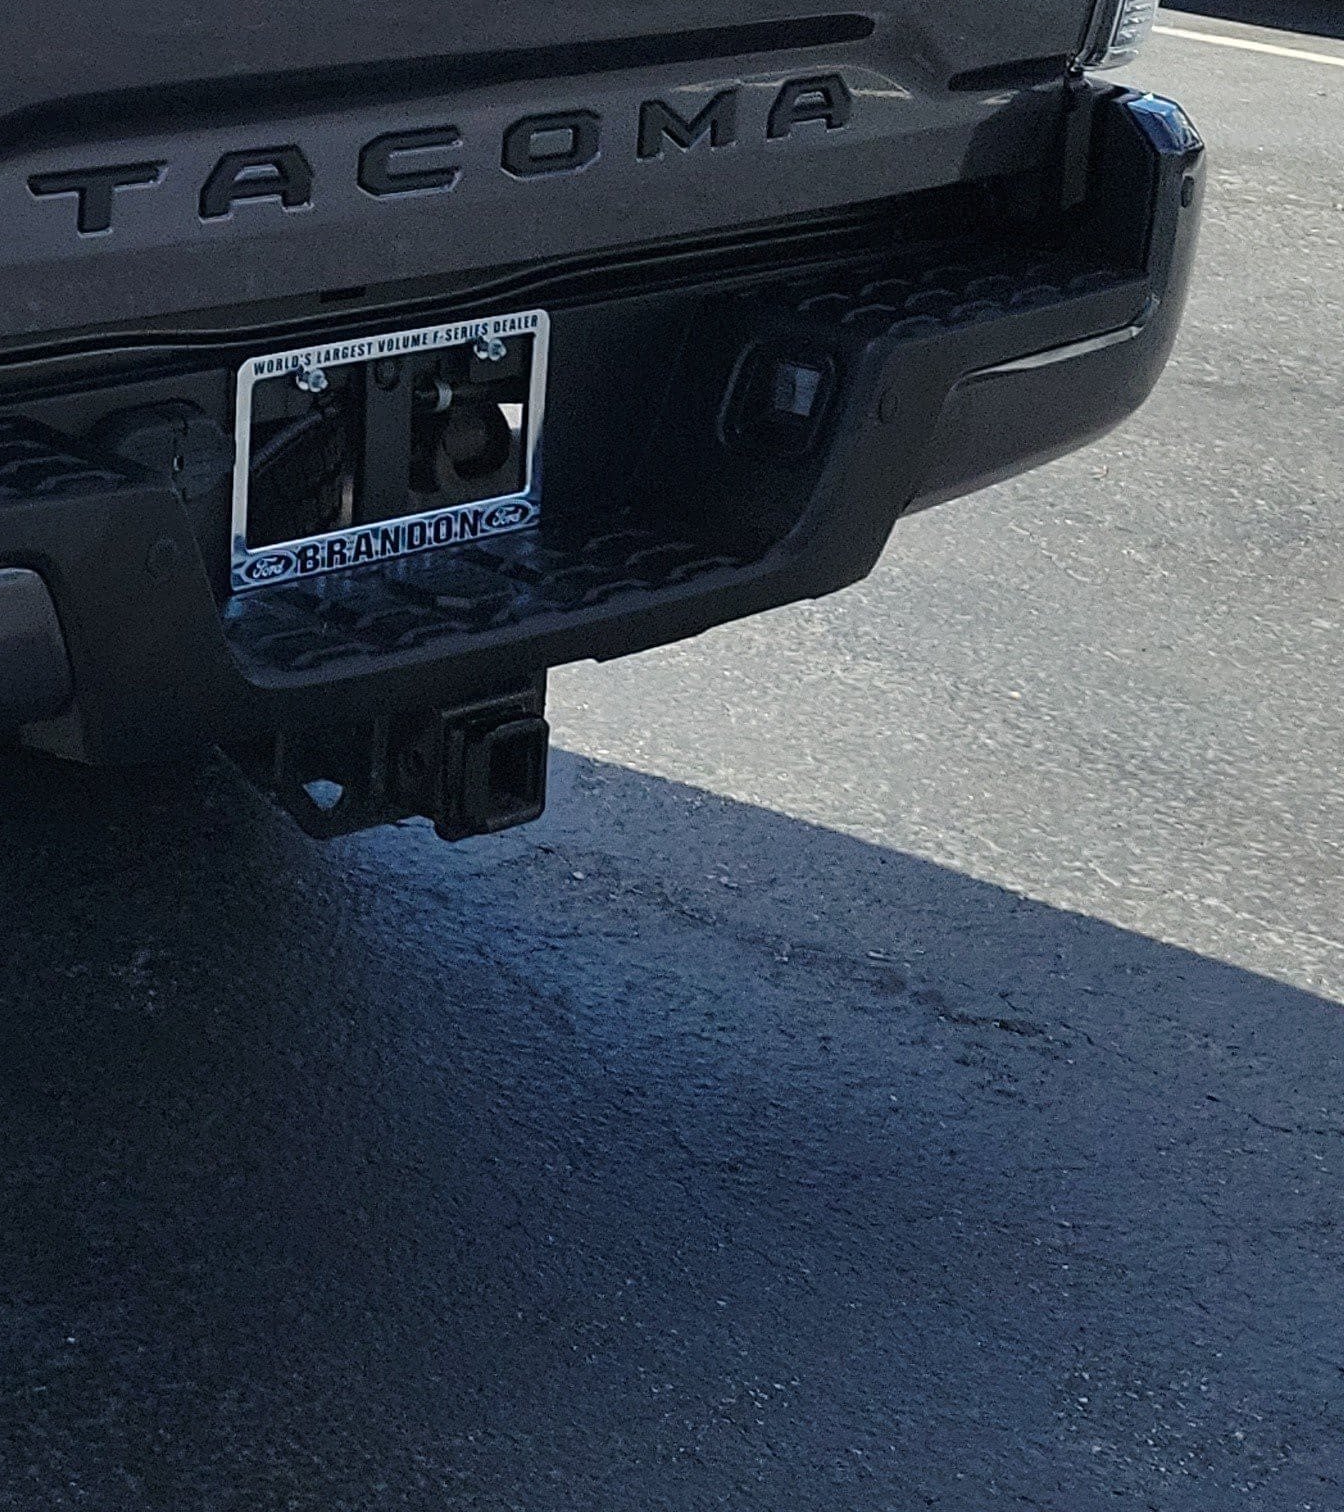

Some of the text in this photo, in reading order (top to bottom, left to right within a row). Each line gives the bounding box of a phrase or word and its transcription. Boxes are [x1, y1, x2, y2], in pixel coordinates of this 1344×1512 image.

[26, 72, 857, 238] TACOMA
[253, 314, 538, 376] WORLD'S LARGEST VOLUME F-SERIES DEALER
[251, 505, 528, 580] Ford BRANDON Ford
